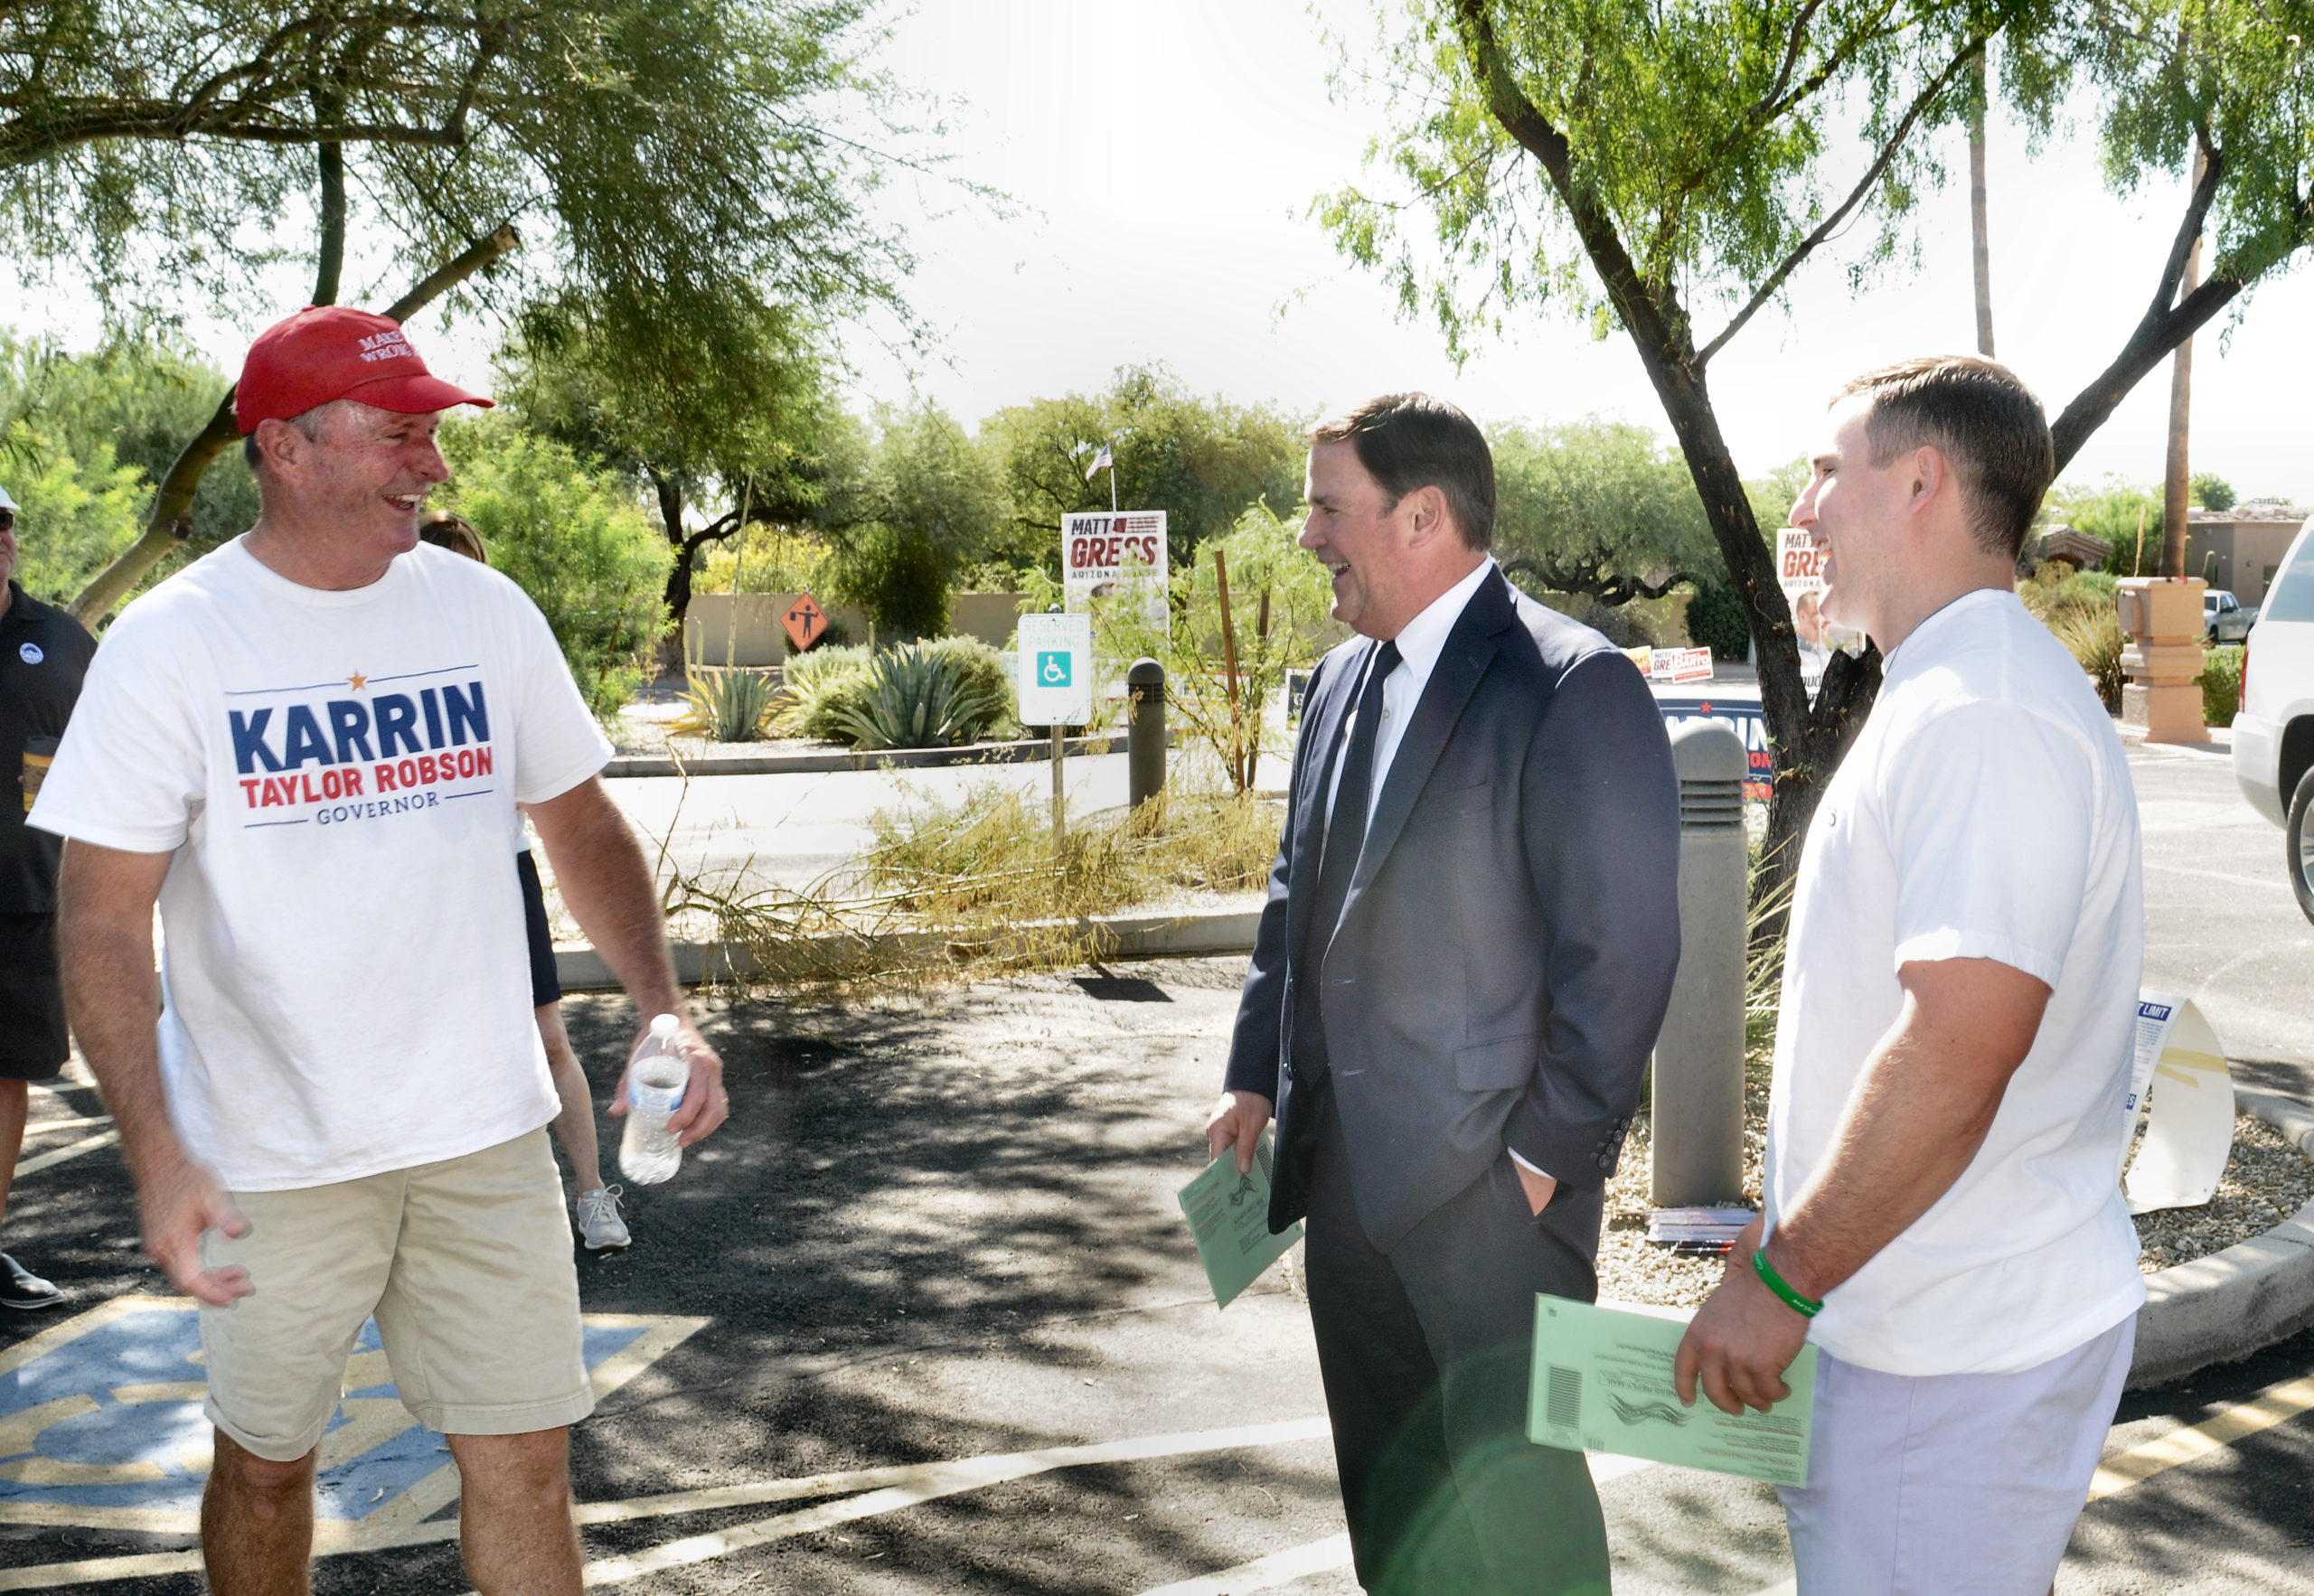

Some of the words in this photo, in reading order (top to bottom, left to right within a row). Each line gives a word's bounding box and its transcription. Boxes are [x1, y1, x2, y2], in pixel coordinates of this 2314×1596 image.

[357, 331, 404, 352] MAKE
[1071, 518, 1111, 535] MATT
[1024, 619, 1084, 633] RESERVED
[1028, 635, 1080, 648] PARKING
[228, 681, 491, 775] KARRIN
[240, 767, 364, 809] TAYLOR
[374, 746, 494, 793] ROBSON
[316, 791, 440, 825] GOVERNOR
[2142, 1004, 2168, 1019] LIMIT
